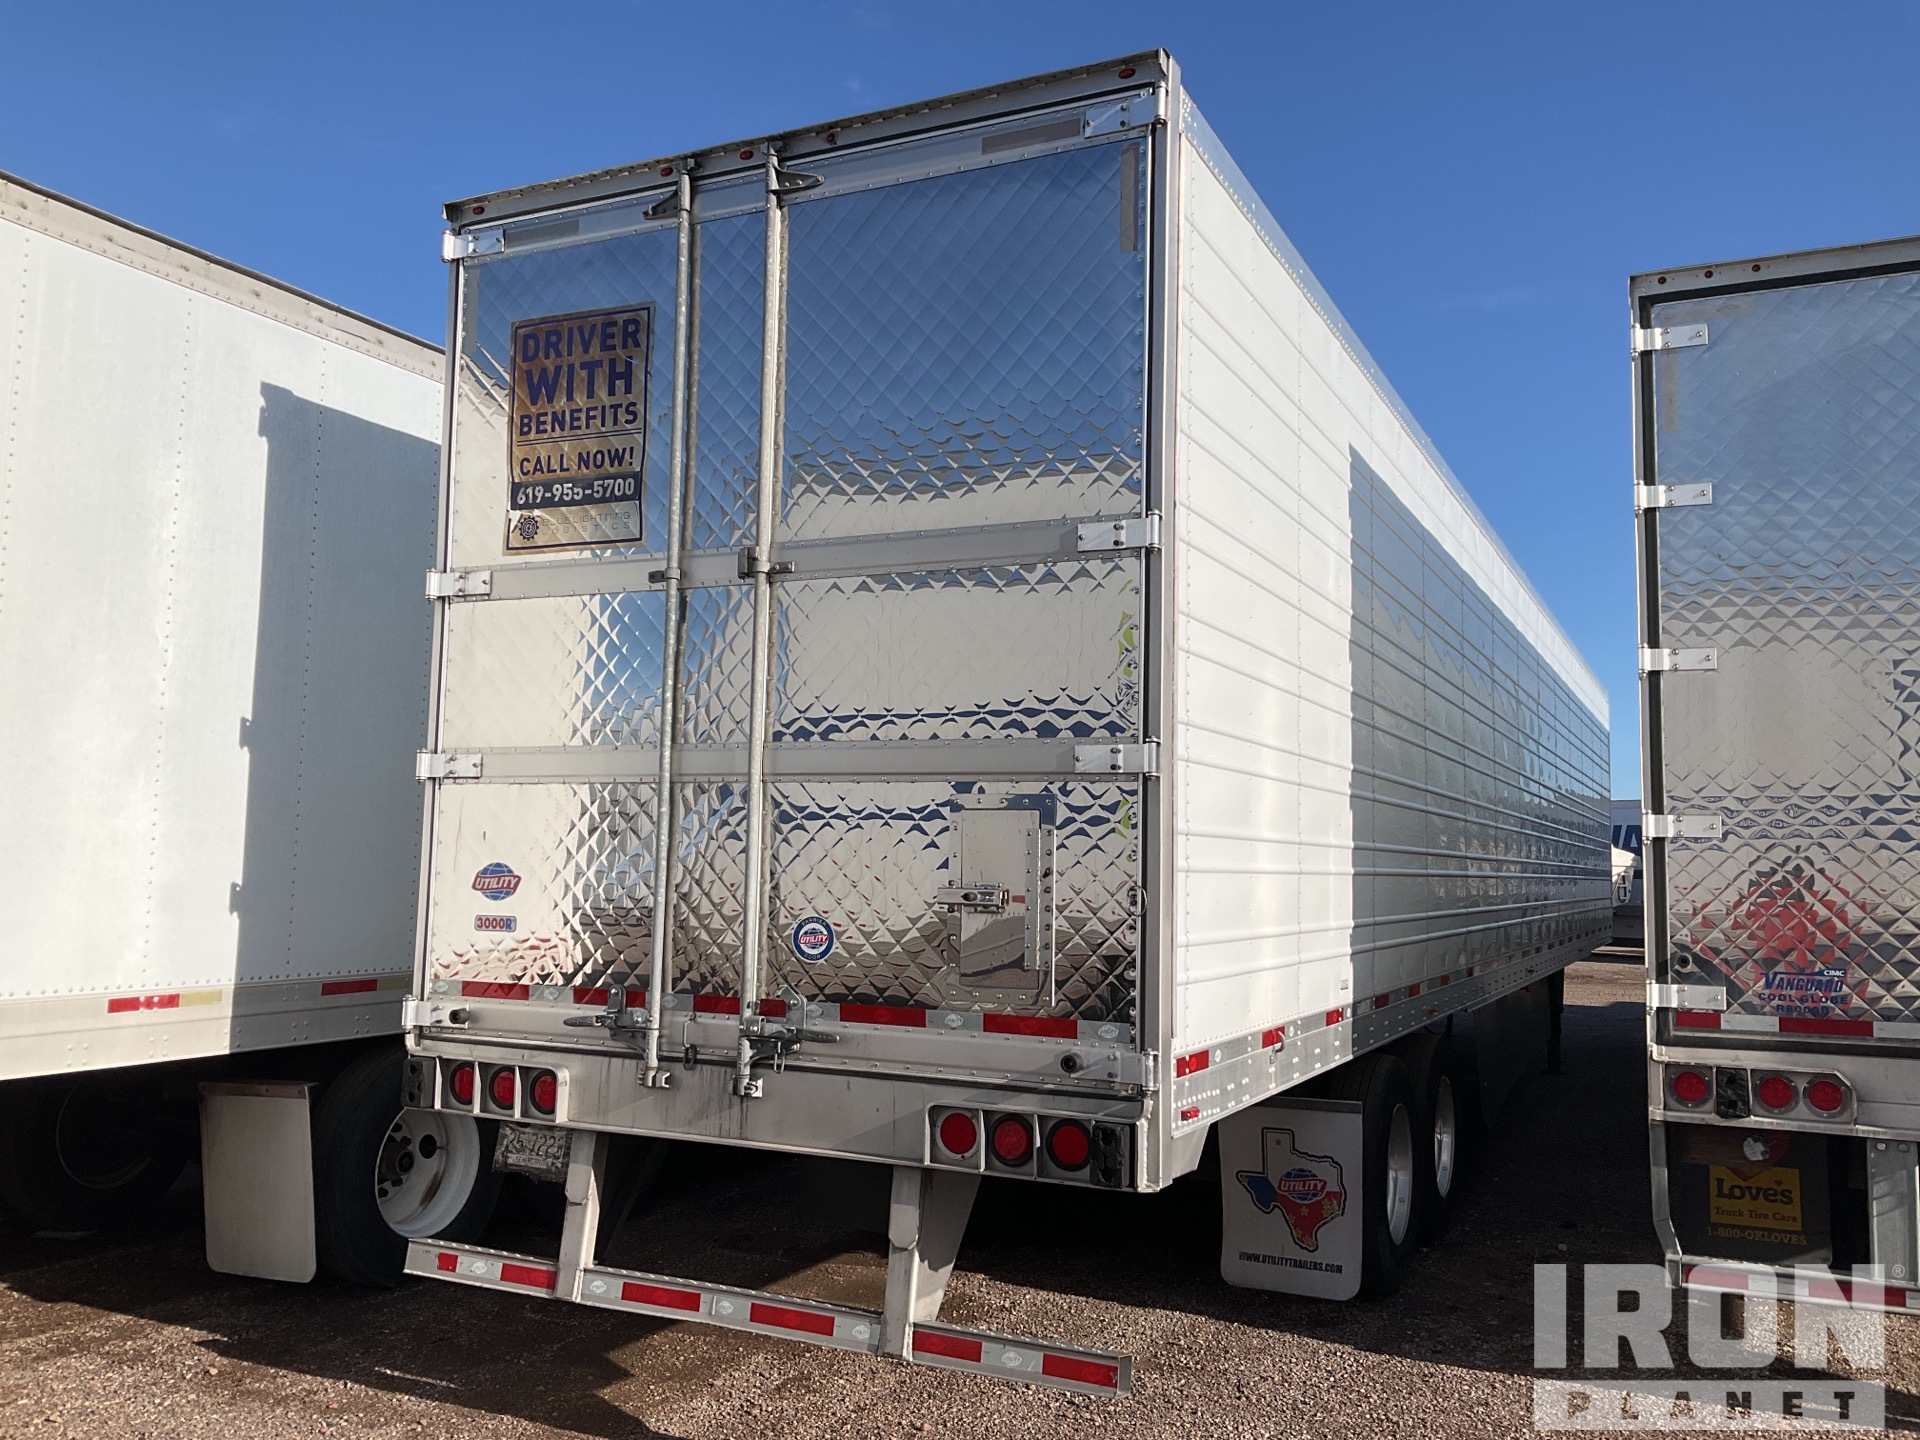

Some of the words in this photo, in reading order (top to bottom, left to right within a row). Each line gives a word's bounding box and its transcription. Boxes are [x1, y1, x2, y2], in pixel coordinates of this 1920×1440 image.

[521, 318, 641, 364] DRIVER
[525, 355, 634, 407] WITH
[519, 401, 638, 437] BENEFITS
[519, 453, 570, 477] CALL
[577, 446, 635, 471] NOW!
[516, 477, 635, 505] 619-955-5700
[541, 521, 631, 536] LOGISTICS
[475, 876, 519, 890] UTILITY
[476, 916, 513, 931] 3000R
[800, 934, 828, 944] UTILITY
[1763, 971, 1844, 993] VANGUARD
[1823, 969, 1845, 977] CIMC
[1758, 992, 1795, 1004] COOL
[1800, 993, 1849, 1005] GLOBE
[1280, 1180, 1324, 1191] UTILITY
[1714, 1206, 1744, 1218] Truck
[1748, 1208, 1770, 1220] Tire
[1773, 1211, 1798, 1223] Care
[1707, 1226, 1808, 1245] 1-800-OKLOVES
[1238, 1250, 1343, 1274] WWW.UTILITYTRAILERS.COM
